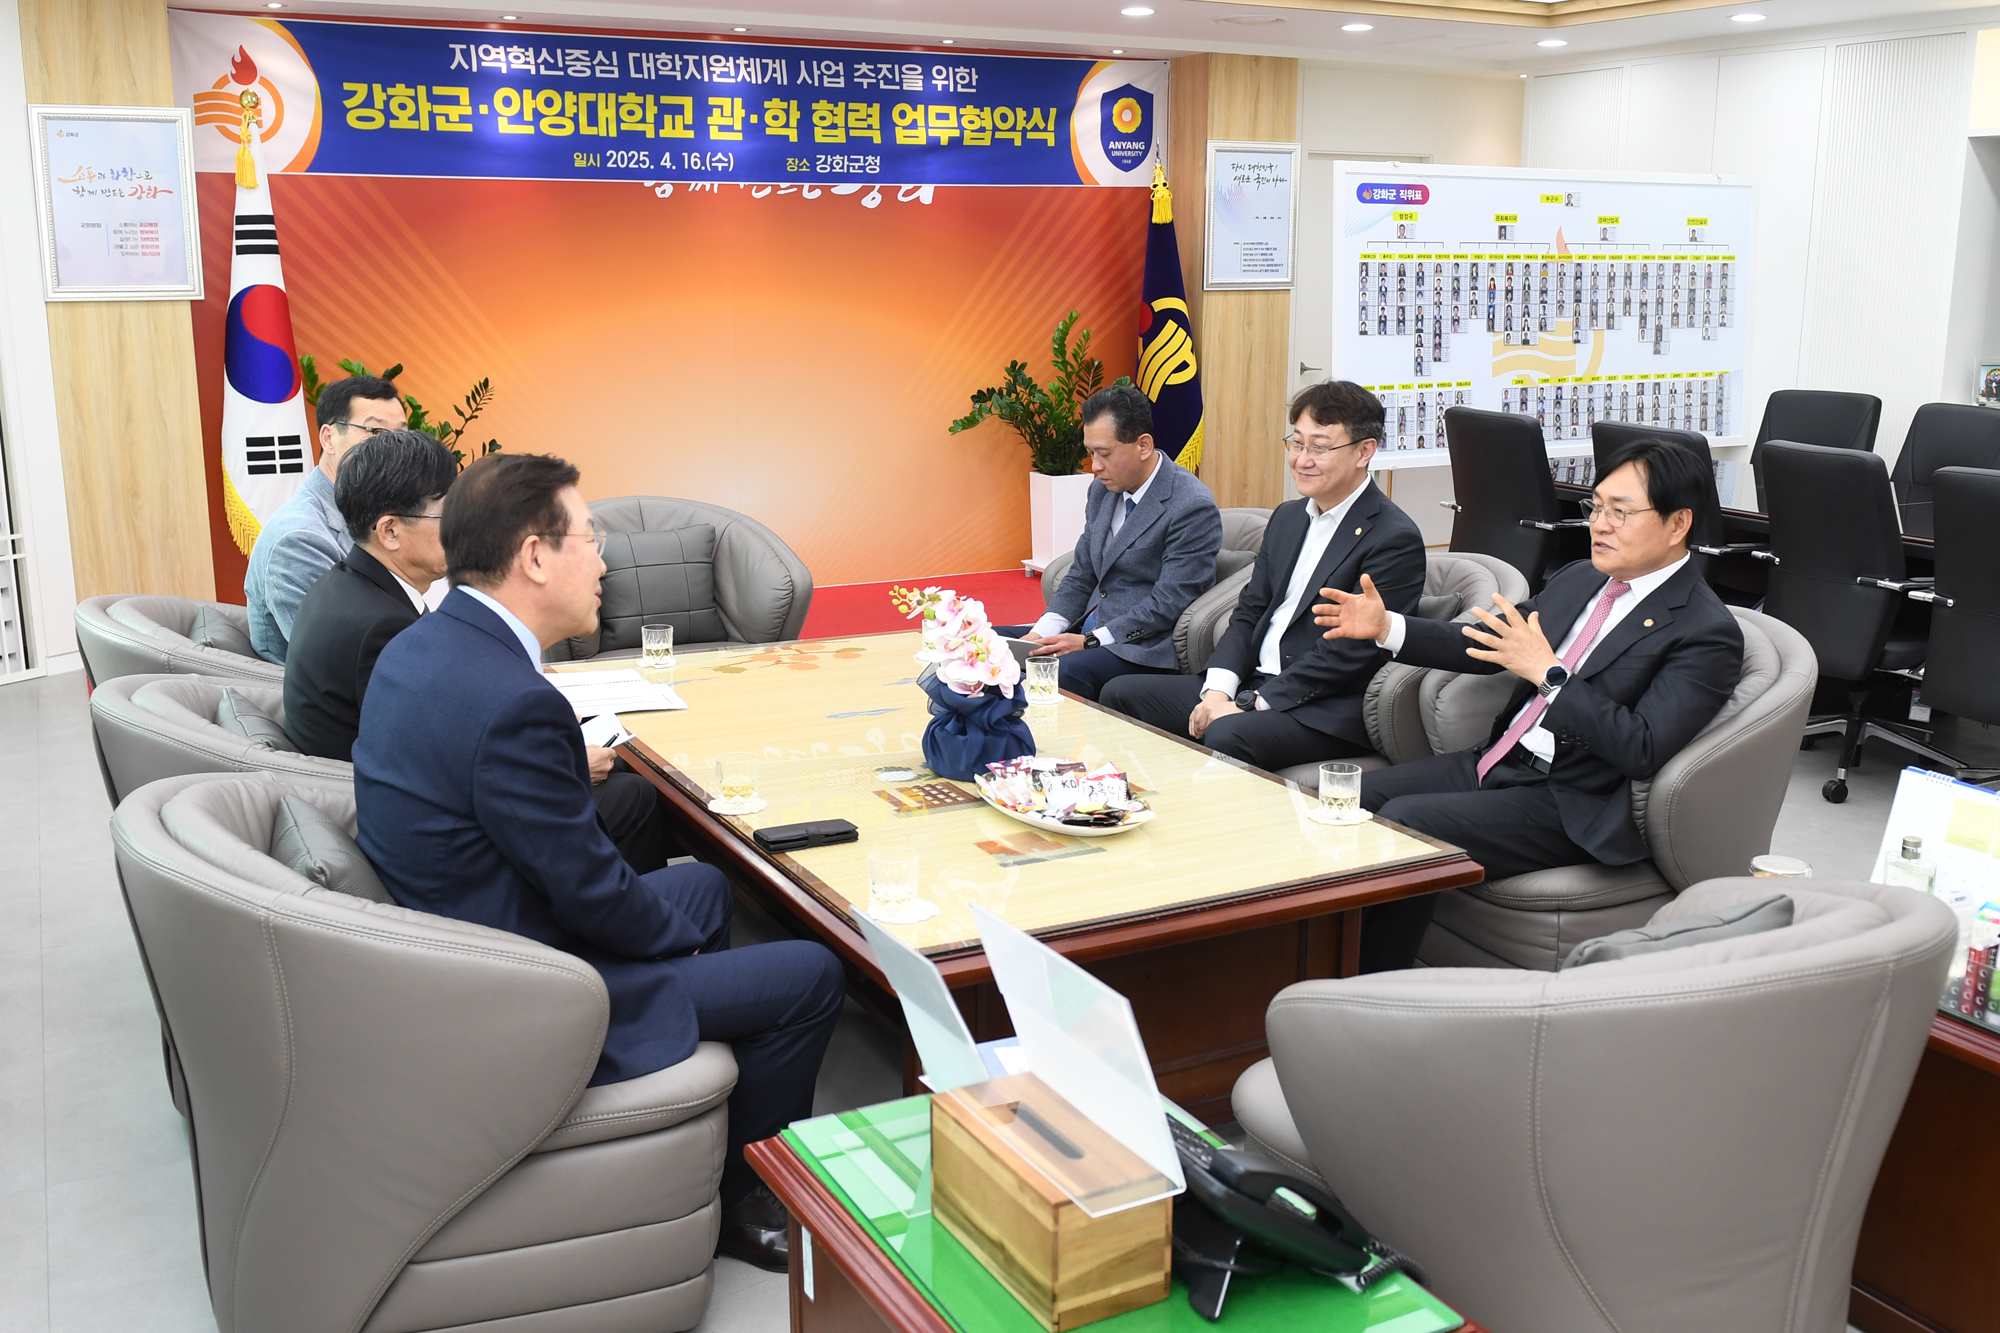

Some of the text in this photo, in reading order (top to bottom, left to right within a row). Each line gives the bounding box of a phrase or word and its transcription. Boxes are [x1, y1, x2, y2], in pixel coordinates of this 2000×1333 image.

[449, 44, 978, 93] 지역혁신중심 대학지원체계 사업 추진을 위한
[342, 82, 1058, 147] 강화군·안양대학교 관·학 협력 업무협약식
[1108, 141, 1145, 150] ANYANG
[573, 150, 734, 171] 일시 2025. 4. 16.(수)
[786, 154, 881, 174] 장소 강화군청
[1231, 162, 1246, 172] 다시
[128, 184, 173, 200] 강화
[1373, 188, 1423, 201] 강화군 직위표
